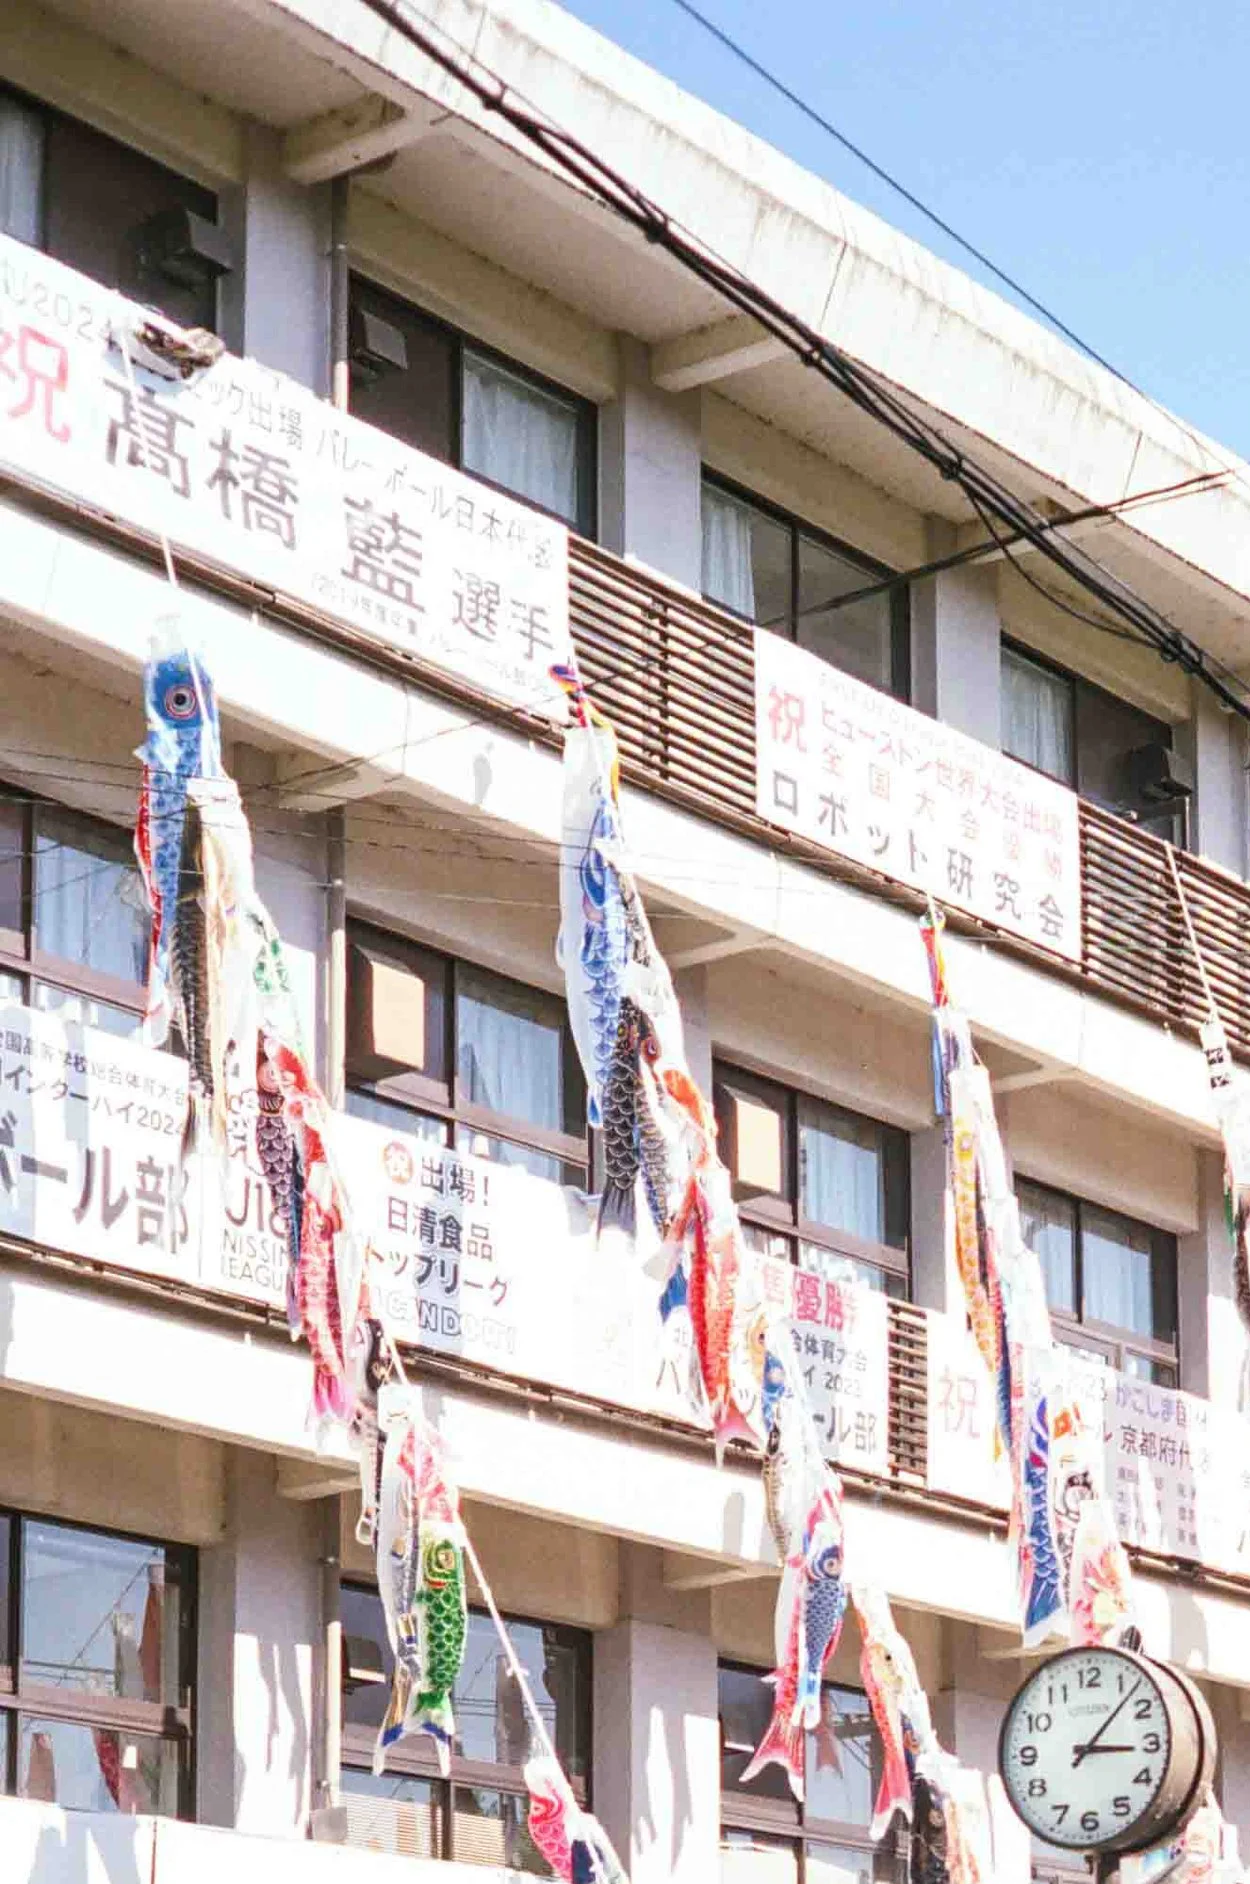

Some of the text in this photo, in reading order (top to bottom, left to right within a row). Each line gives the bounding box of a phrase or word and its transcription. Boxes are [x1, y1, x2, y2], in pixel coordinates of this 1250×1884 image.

[0, 322, 72, 445] 祝
[451, 567, 556, 662] 選手
[766, 683, 808, 754] 祝
[771, 769, 1066, 942] ロボット研究会
[386, 1195, 495, 1263] 日清食品
[221, 1256, 284, 1292] LEAGU
[935, 1364, 982, 1440] 祝
[1077, 1667, 1101, 1689] 12
[1117, 1673, 1124, 1693] 1
[1047, 1684, 1068, 1704] 11
[1133, 1698, 1152, 1720] 2
[1027, 1712, 1052, 1734] 10
[1143, 1733, 1161, 1754] 3
[1020, 1745, 1038, 1766] 9
[1132, 1767, 1152, 1786] 4
[1028, 1778, 1047, 1798] 8
[1052, 1804, 1070, 1826] 7
[1113, 1796, 1131, 1817] 5
[1080, 1811, 1100, 1832] 6
